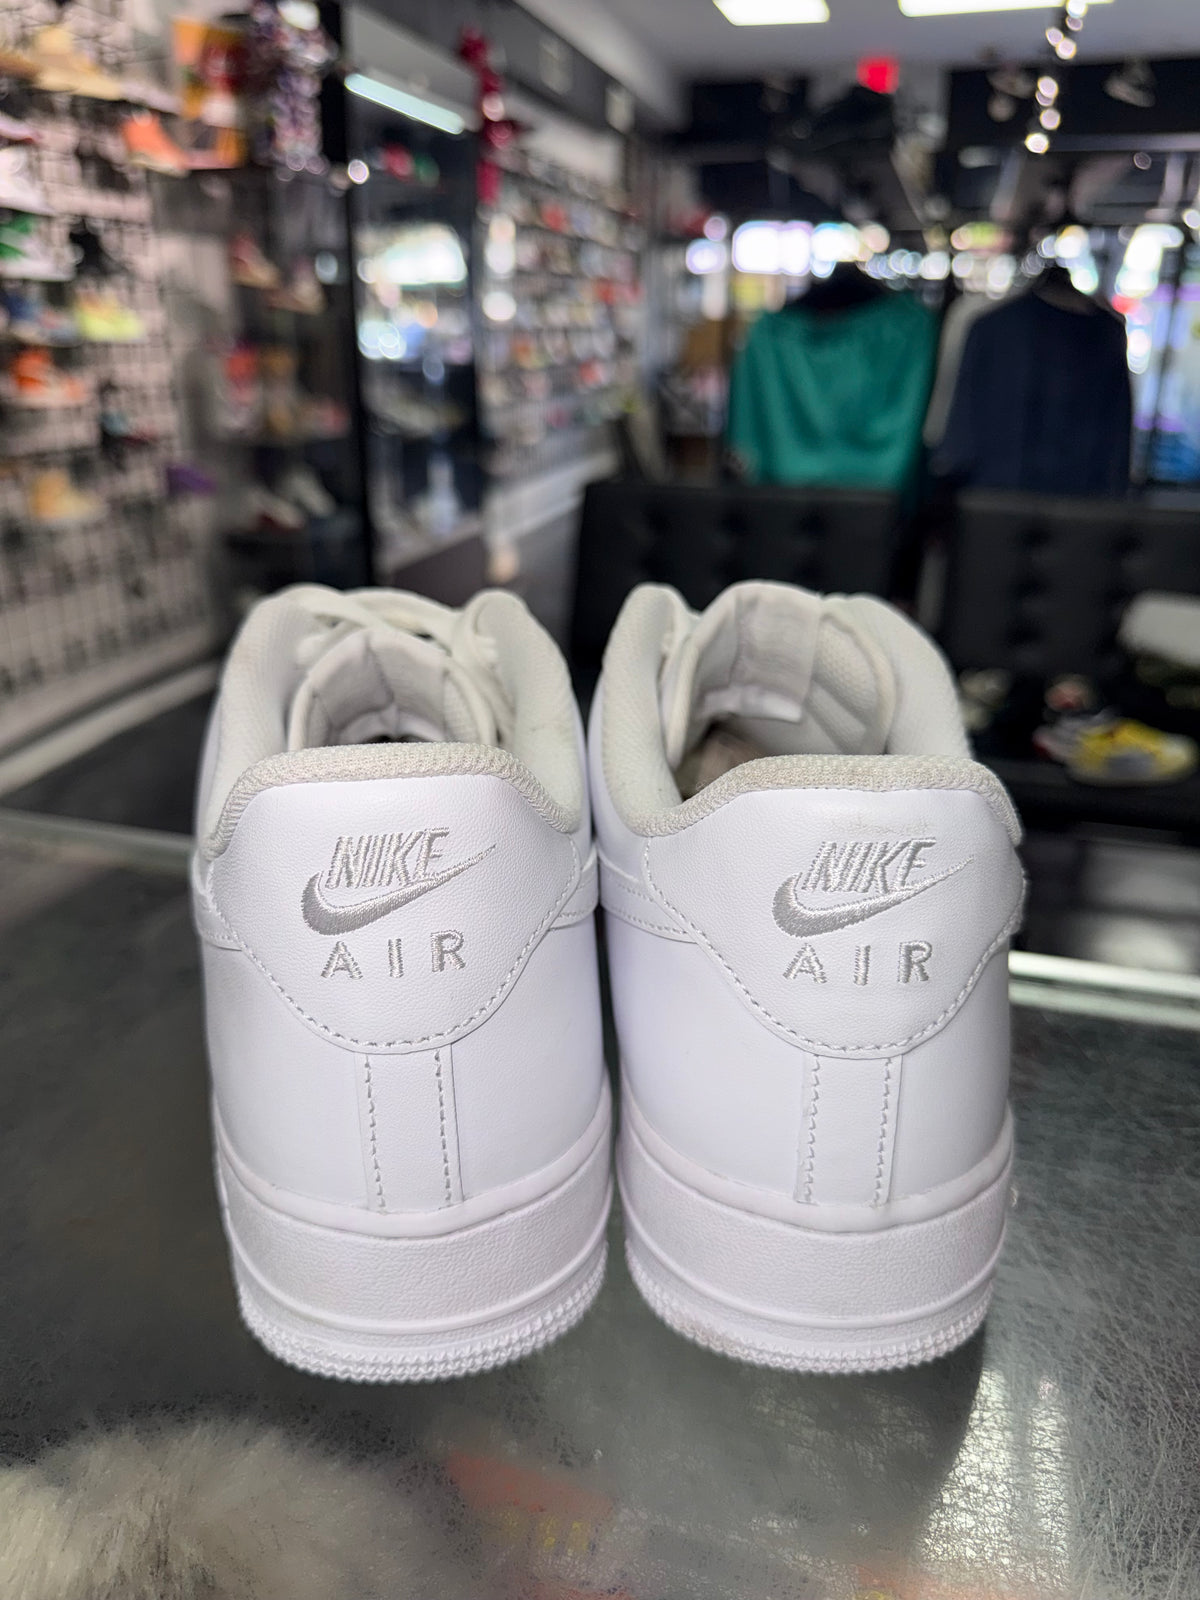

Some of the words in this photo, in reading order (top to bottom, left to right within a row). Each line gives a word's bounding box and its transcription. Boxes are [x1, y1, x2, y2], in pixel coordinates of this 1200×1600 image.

[325, 827, 450, 889] NIKE
[801, 837, 936, 894] NIKE
[320, 929, 466, 979] AIR
[783, 940, 932, 986] AIR
